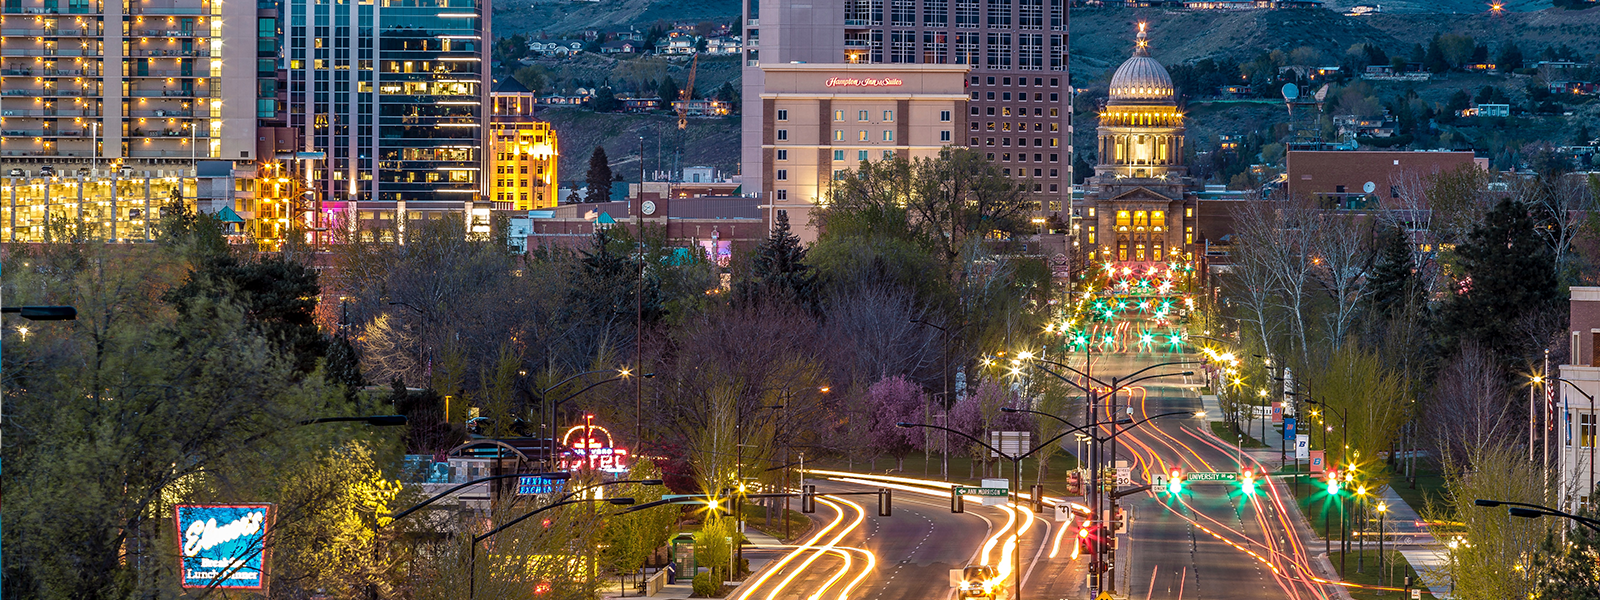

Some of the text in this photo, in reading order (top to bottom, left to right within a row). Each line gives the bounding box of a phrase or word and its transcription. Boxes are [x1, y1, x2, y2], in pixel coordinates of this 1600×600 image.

[825, 77, 860, 87] Hampton
[861, 77, 879, 87] Inn
[884, 77, 903, 87] Suites
[1118, 477, 1130, 485] 30
[519, 485, 564, 494] EXCHANE
